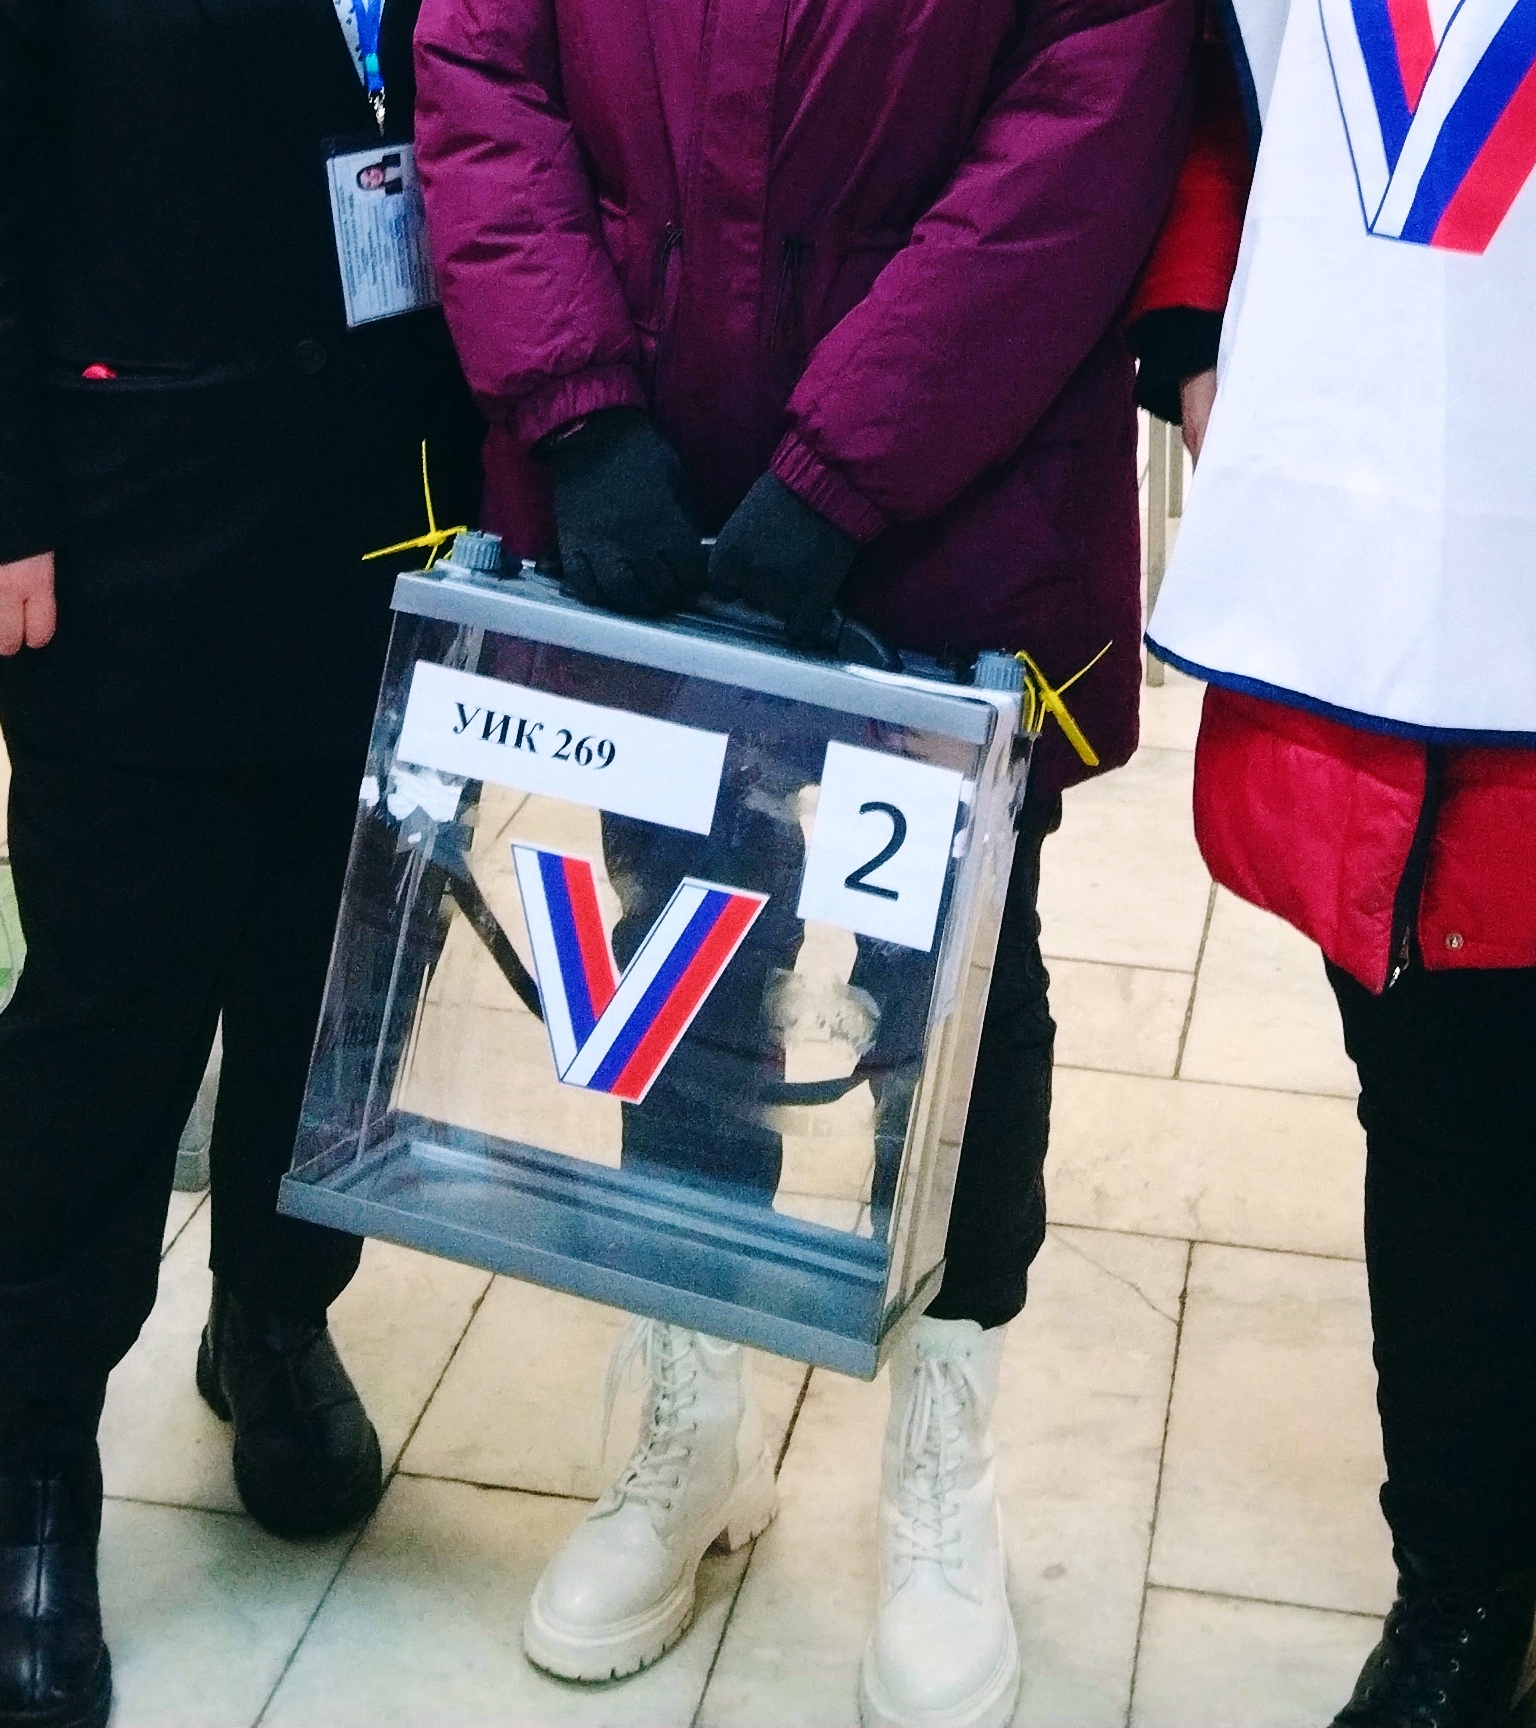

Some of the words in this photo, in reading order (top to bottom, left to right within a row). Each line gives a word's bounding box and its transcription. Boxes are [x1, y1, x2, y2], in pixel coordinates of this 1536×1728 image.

[452, 701, 543, 754] УИК
[555, 728, 617, 772] 269
[842, 800, 909, 901] 2
